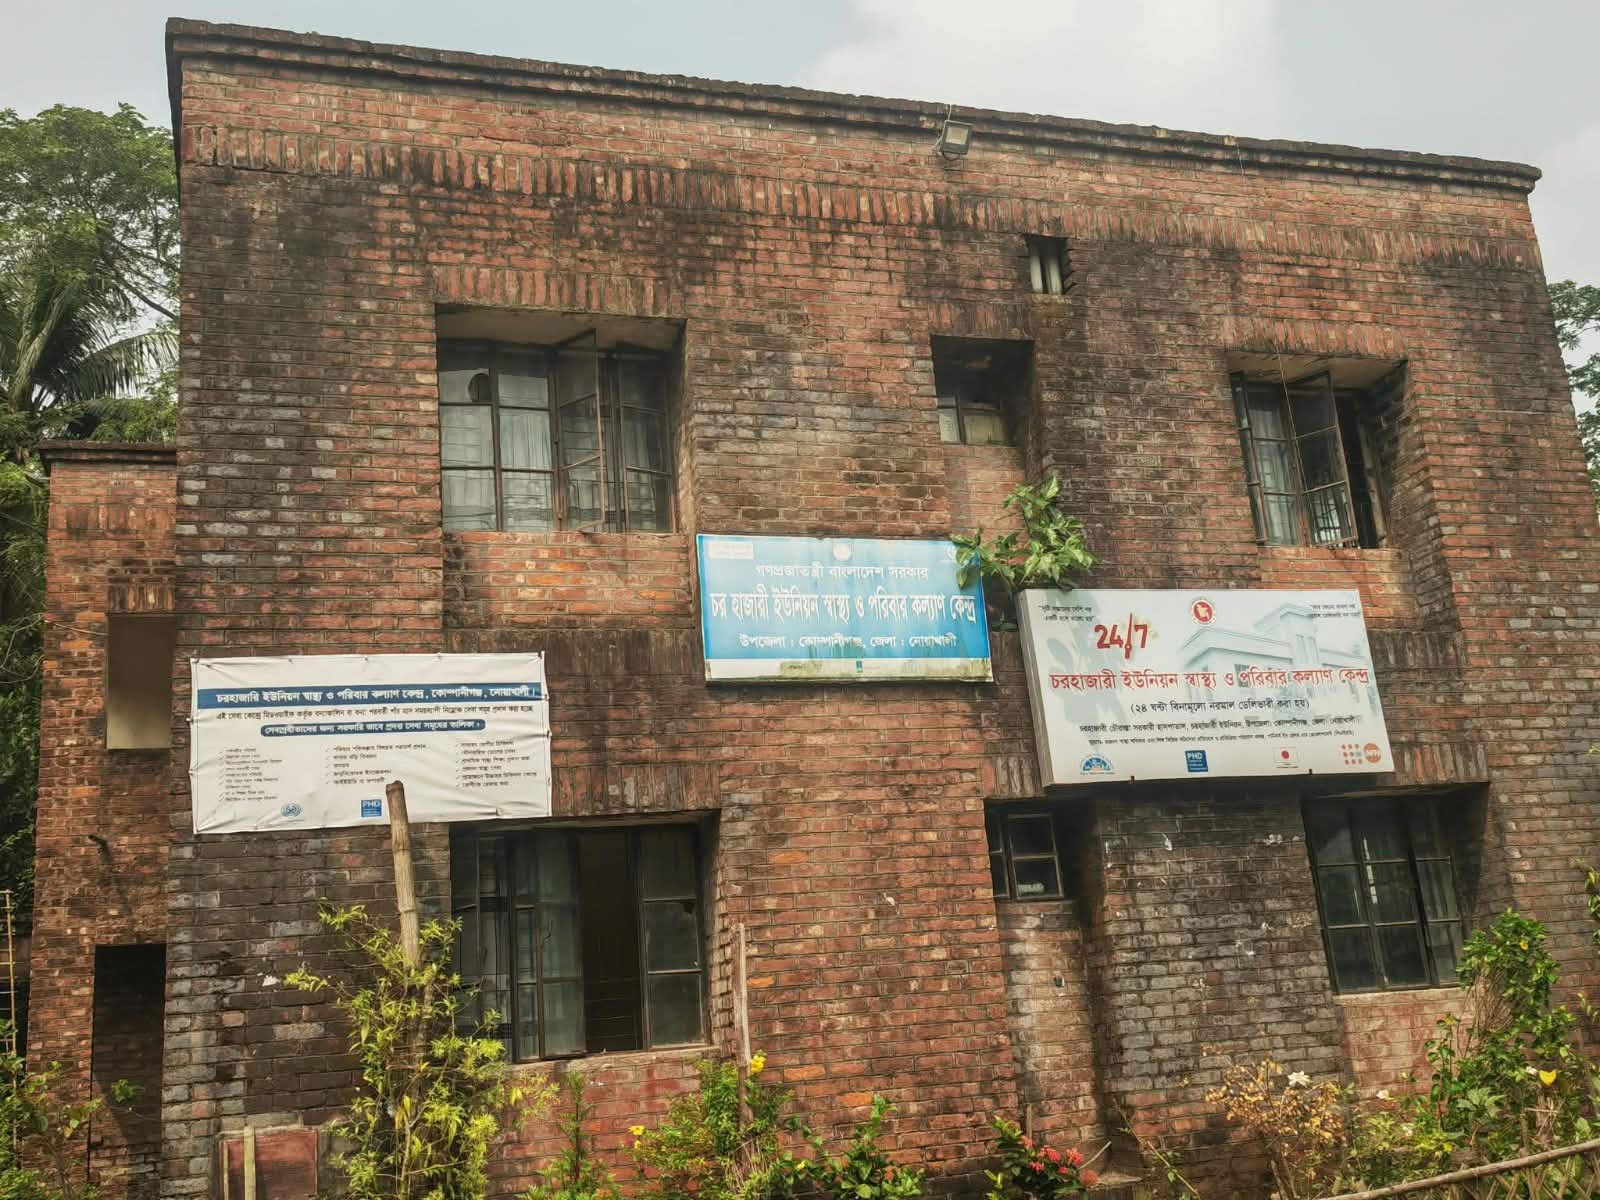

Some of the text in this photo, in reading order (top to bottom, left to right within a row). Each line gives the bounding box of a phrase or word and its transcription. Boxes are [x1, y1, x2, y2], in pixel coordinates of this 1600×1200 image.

[826, 566, 883, 579] বাংলাদেশ
[888, 566, 928, 579] সরকার
[709, 583, 976, 624] চর হাজারী ইউনিয়ন স্বাস্থ্য ও পরিবার কল্যাণ কেন্দ্র
[1049, 665, 1369, 691] চরহাজারী ইউনিয়ন স্বাস্থ্য ও পরিবার কল্যাণ কেন্দ্র
[216, 690, 259, 703] চরহাজারি
[263, 689, 299, 703] ইউনিয়ন
[303, 691, 322, 703] স্বাস্থ্য
[326, 691, 334, 700] ও
[337, 688, 368, 700] পরিবার
[371, 688, 399, 700] কল্যাণ
[1130, 703, 1148, 713] (২৪
[1150, 701, 1168, 712] ঘন্টা
[1208, 701, 1235, 710] নরমাল
[1276, 699, 1292, 708] করা
[1294, 698, 1309, 709] হয়)
